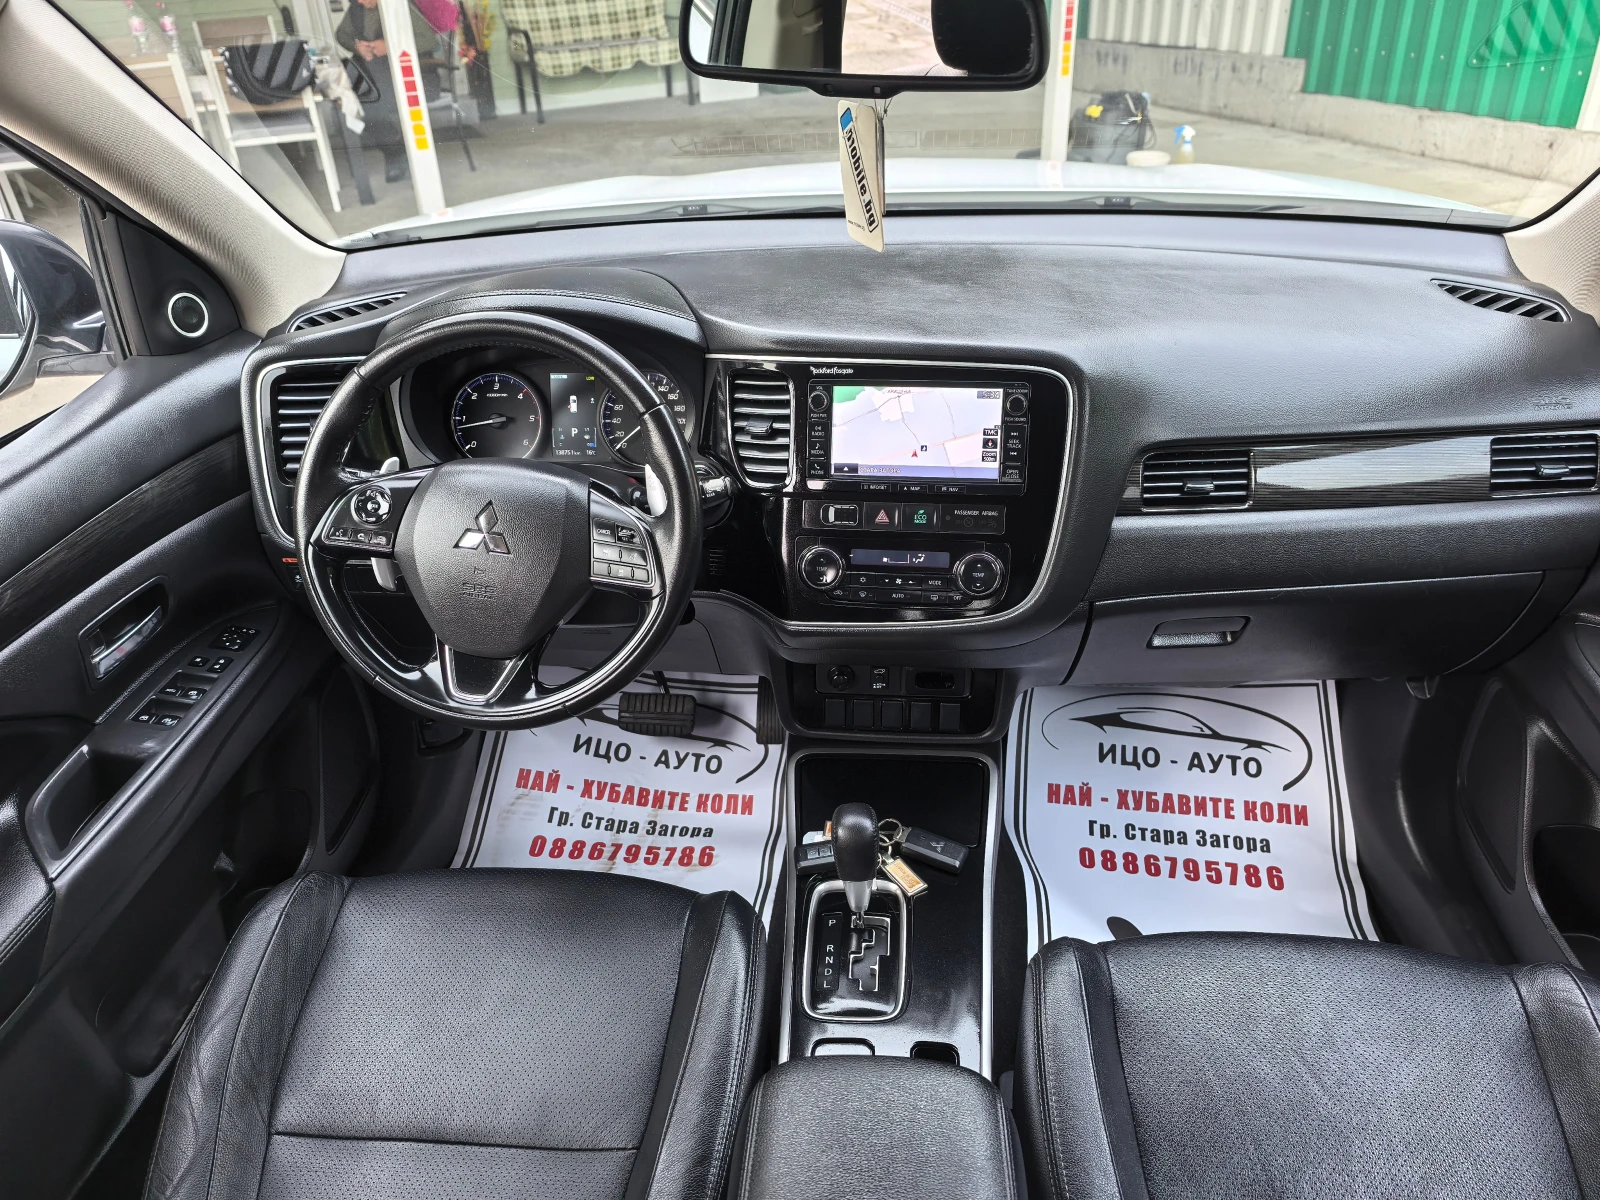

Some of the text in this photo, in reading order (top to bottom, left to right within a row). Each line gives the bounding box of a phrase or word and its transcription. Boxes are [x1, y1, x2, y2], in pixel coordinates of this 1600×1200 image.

[846, 127, 877, 228] mobile.bg
[471, 392, 478, 400] 2
[571, 427, 579, 437] P
[573, 733, 632, 763] ИЦО
[653, 749, 723, 774] АУТО
[1098, 742, 1161, 771] ИЦО
[1187, 752, 1263, 778] АУТО
[515, 768, 561, 794] НАЙ
[580, 779, 689, 812] ХУБАВИТЕ
[696, 793, 754, 815] КОЛИ
[1047, 782, 1092, 807] НАЙ
[1116, 789, 1235, 820] ХУБАВИТЕ
[1243, 800, 1309, 827] КОЛИ
[547, 806, 714, 838] Гр. Стара Загора
[1088, 819, 1271, 853] Гр. Стара Загора
[528, 834, 716, 867] 0886795786
[1078, 847, 1285, 891] 0886795786
[828, 919, 836, 927] P
[825, 956, 833, 964] N
[826, 944, 834, 952] R
[823, 980, 831, 988] L
[824, 968, 832, 976] D
